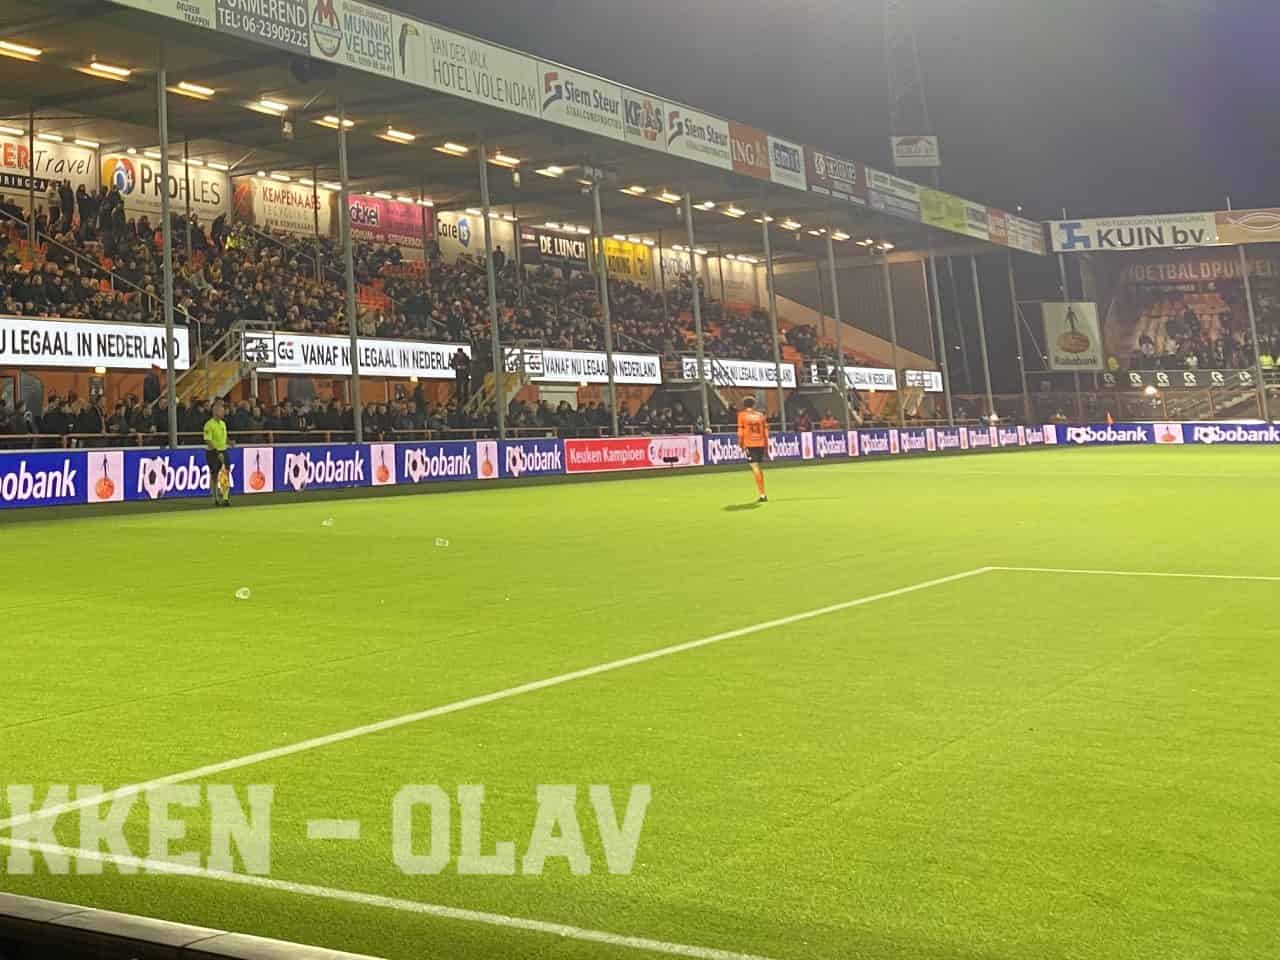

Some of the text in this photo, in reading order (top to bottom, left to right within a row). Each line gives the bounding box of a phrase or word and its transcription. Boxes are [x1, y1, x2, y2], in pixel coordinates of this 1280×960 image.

[343, 13, 391, 44] MUNNIK
[344, 32, 391, 63] VELDER
[432, 56, 472, 92] HOTEL
[474, 69, 538, 111] VOLENDAM
[564, 80, 620, 115] Siem Steur
[35, 150, 93, 175] Travel
[539, 235, 586, 258] DE LUNCH
[1096, 226, 1165, 248] KUIN
[11, 329, 73, 358] LEGAAL
[77, 331, 91, 357] IN
[96, 333, 181, 361] NEDERLAND
[301, 343, 339, 367] VANAF
[359, 345, 398, 369] LEGAAL
[400, 347, 410, 369] IN
[412, 348, 459, 371] NEDERLA
[544, 358, 570, 375] VANAF
[620, 361, 656, 378] NEDERLAND
[1067, 426, 1148, 442] Rbobank
[1194, 425, 1280, 442] Rbobank
[284, 450, 365, 485] Rbobank
[404, 447, 472, 479] Rbobank
[506, 444, 562, 473] Rbobank
[137, 456, 235, 494] Rbobak
